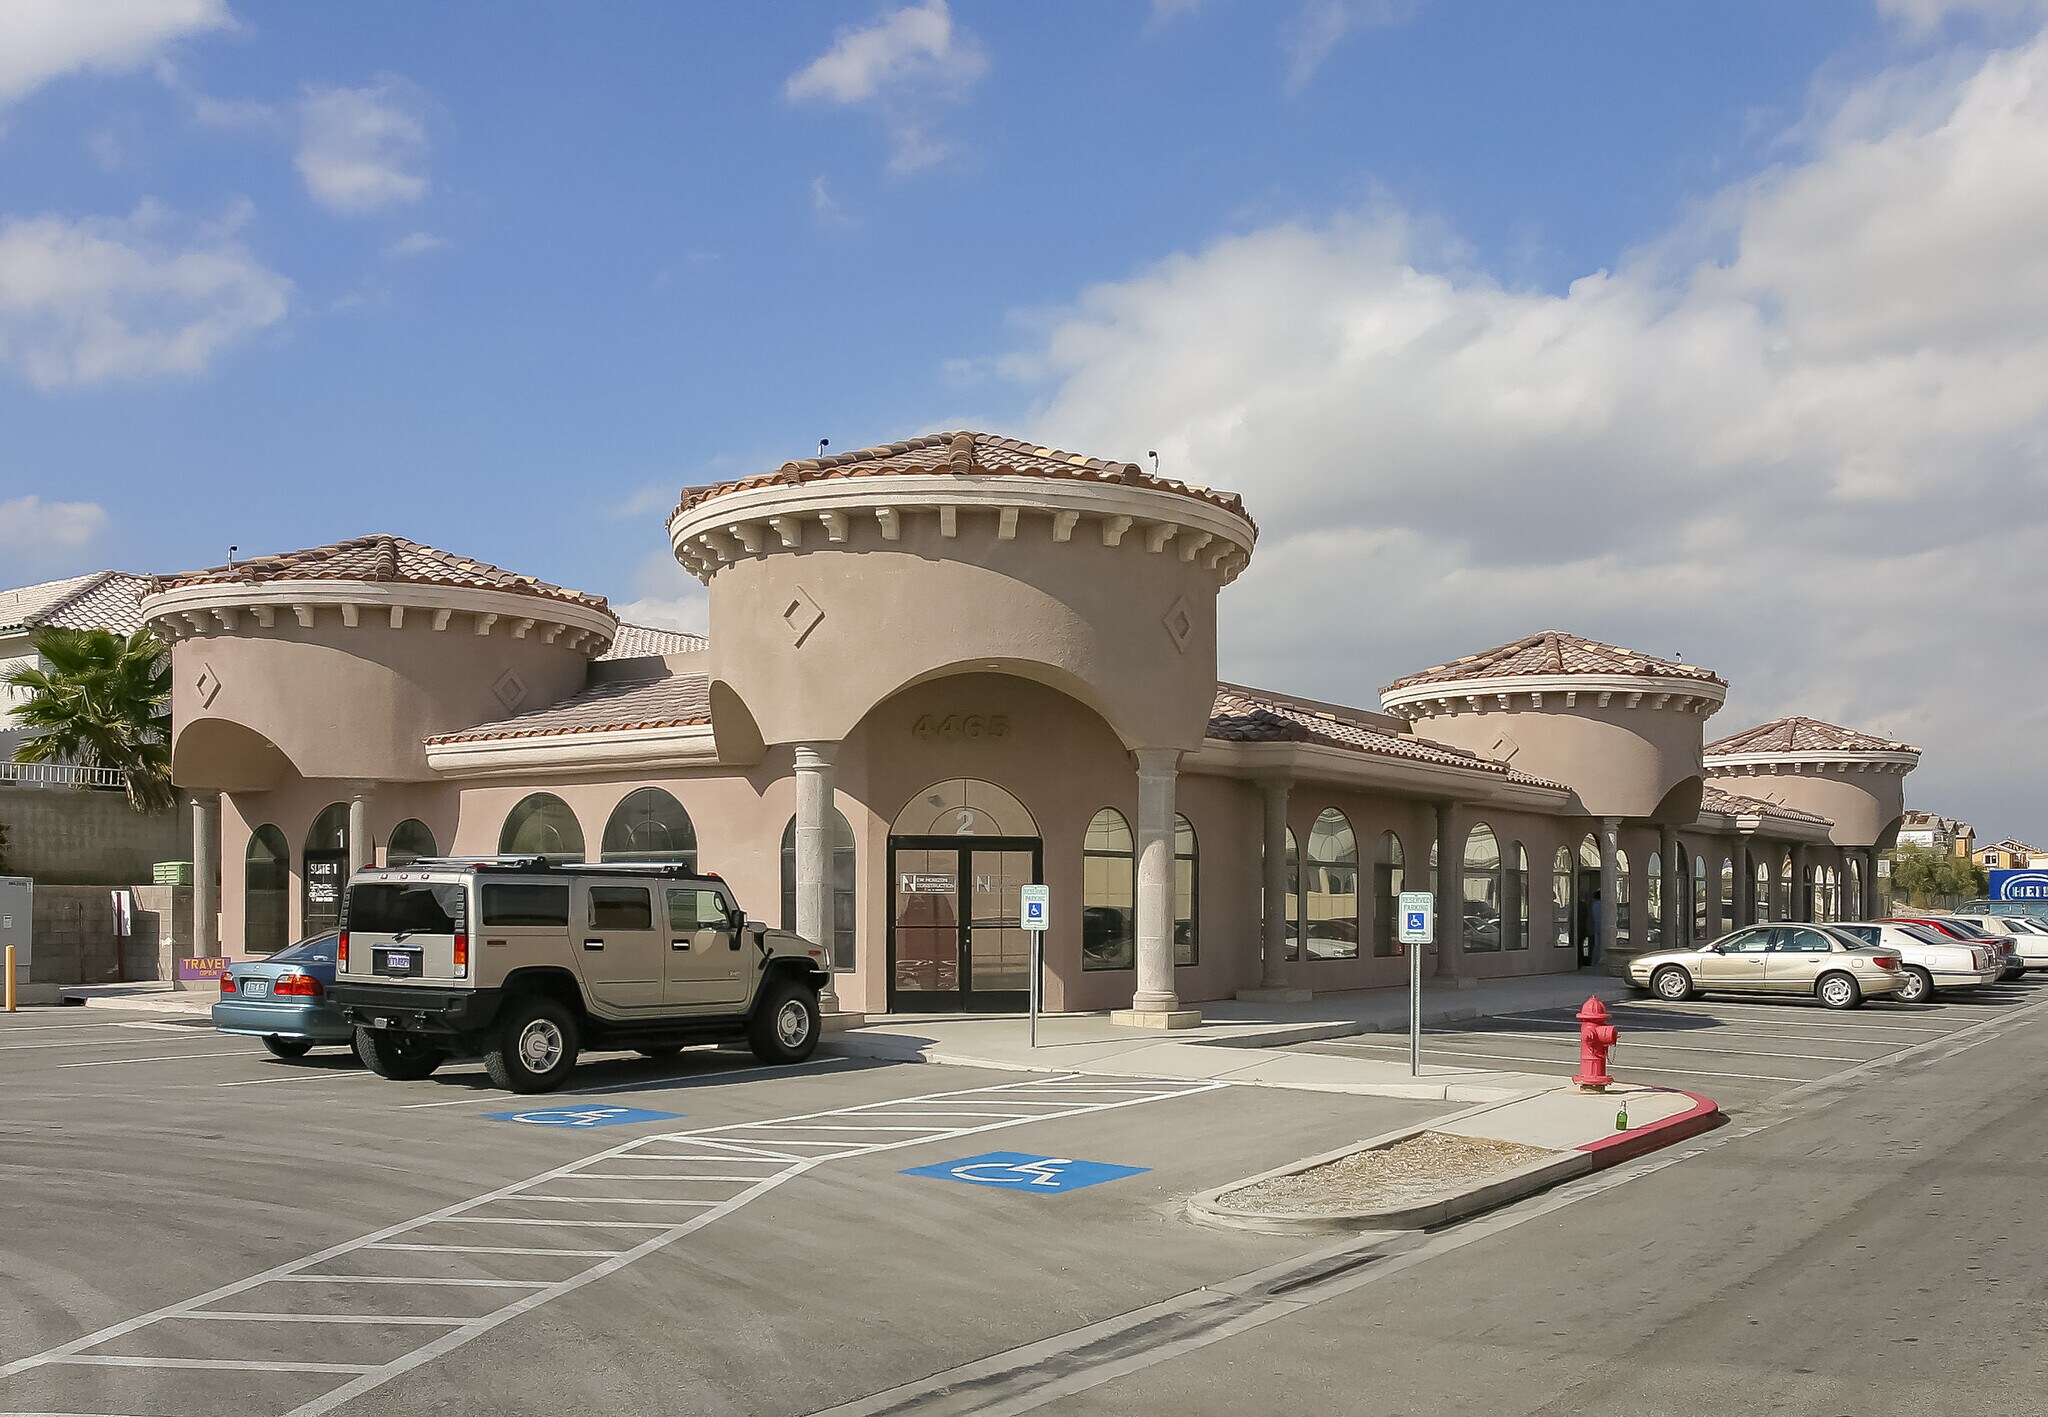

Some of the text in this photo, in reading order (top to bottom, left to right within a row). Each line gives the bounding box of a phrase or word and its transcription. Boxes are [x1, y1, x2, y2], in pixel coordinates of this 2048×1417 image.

[911, 714, 1011, 740] 4465
[956, 811, 974, 836] 2
[337, 829, 343, 848] 1
[310, 864, 337, 874] SUITE 1
[183, 959, 225, 969] TRAVEL
